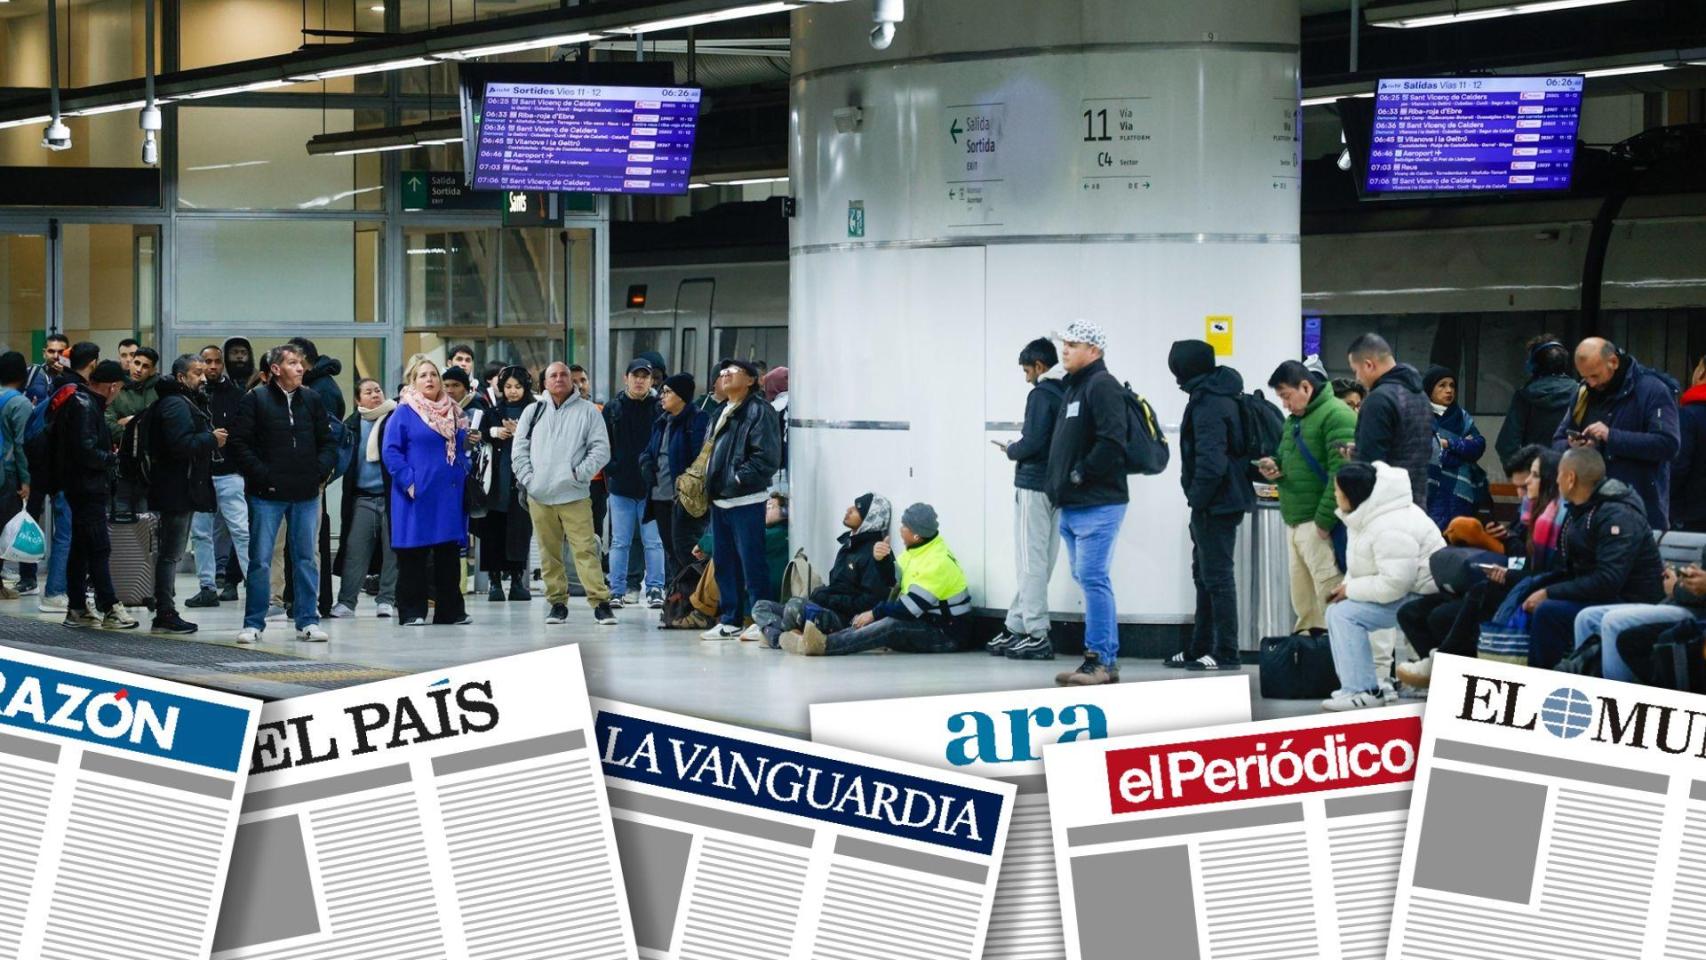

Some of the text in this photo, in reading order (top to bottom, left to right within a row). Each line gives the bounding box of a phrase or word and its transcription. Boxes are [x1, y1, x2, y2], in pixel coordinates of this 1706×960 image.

[1208, 31, 1214, 43] 9
[1403, 81, 1438, 90] Salidas
[1459, 81, 1466, 89] 11
[1473, 81, 1482, 89] 12
[1546, 78, 1572, 86] 06:26
[513, 86, 555, 95] Sortides
[557, 87, 575, 95] Vies
[592, 88, 602, 97] 12
[661, 88, 689, 97] 06:26
[966, 117, 990, 132] Salida
[1083, 108, 1112, 142] 11
[1119, 121, 1133, 131] Via
[1457, 121, 1484, 129] Calders
[570, 126, 598, 134] Calders
[966, 138, 996, 153] Sortida
[512, 151, 545, 159] Aeroport
[1403, 150, 1433, 158] Aeroport
[1098, 151, 1113, 168] C4
[431, 176, 456, 185] Salida
[477, 176, 499, 184] 07:06
[1416, 177, 1439, 186] Vicenç
[431, 186, 461, 196] Sortida
